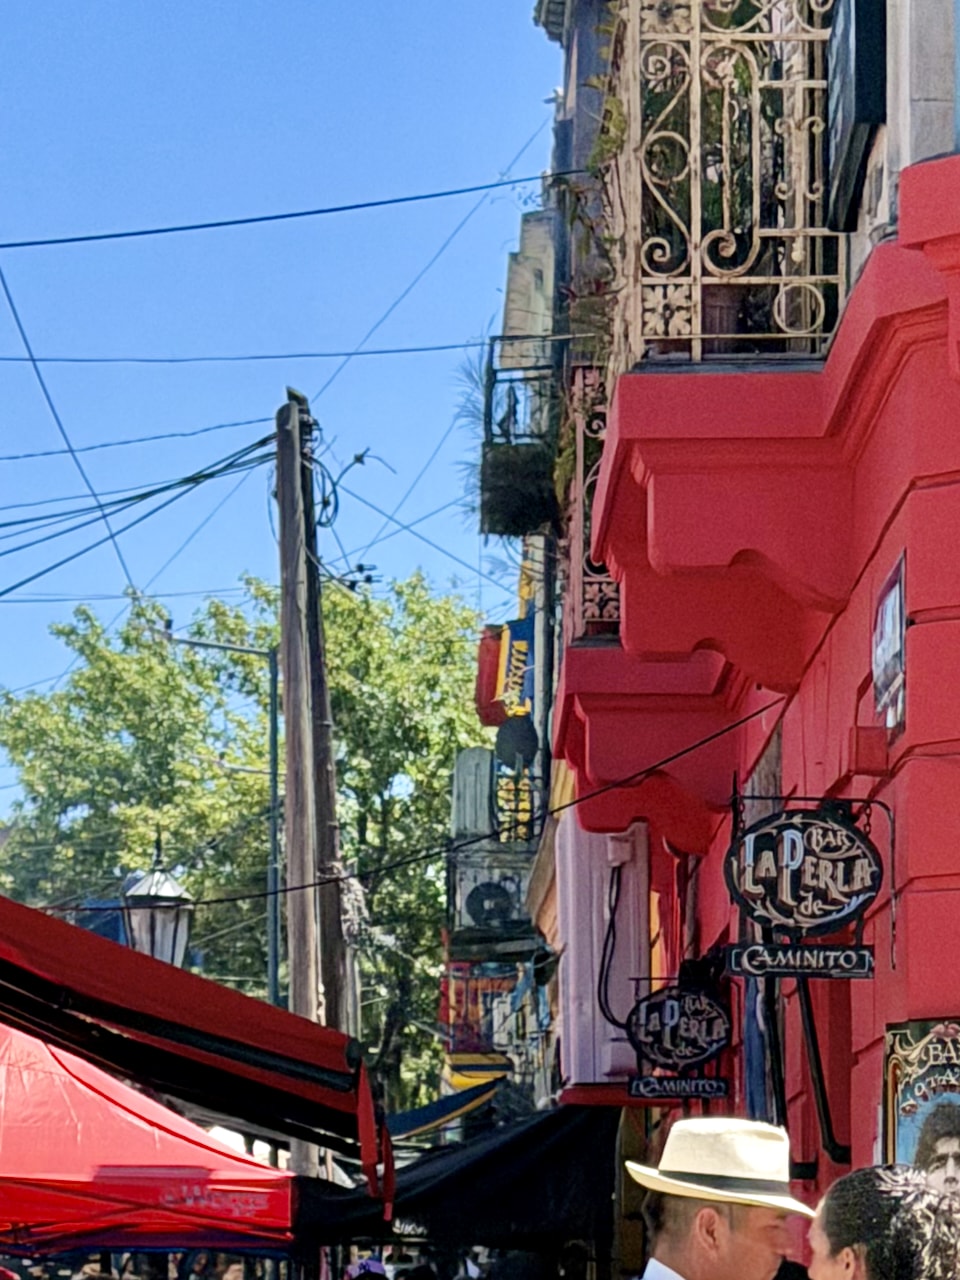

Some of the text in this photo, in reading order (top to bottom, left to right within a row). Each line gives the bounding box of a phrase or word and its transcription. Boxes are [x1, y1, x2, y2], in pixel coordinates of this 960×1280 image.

[811, 826, 852, 852] BAR
[779, 829, 874, 905] PERLA
[741, 946, 858, 974] CAMINITO
[640, 1076, 718, 1097] CAMINITO
